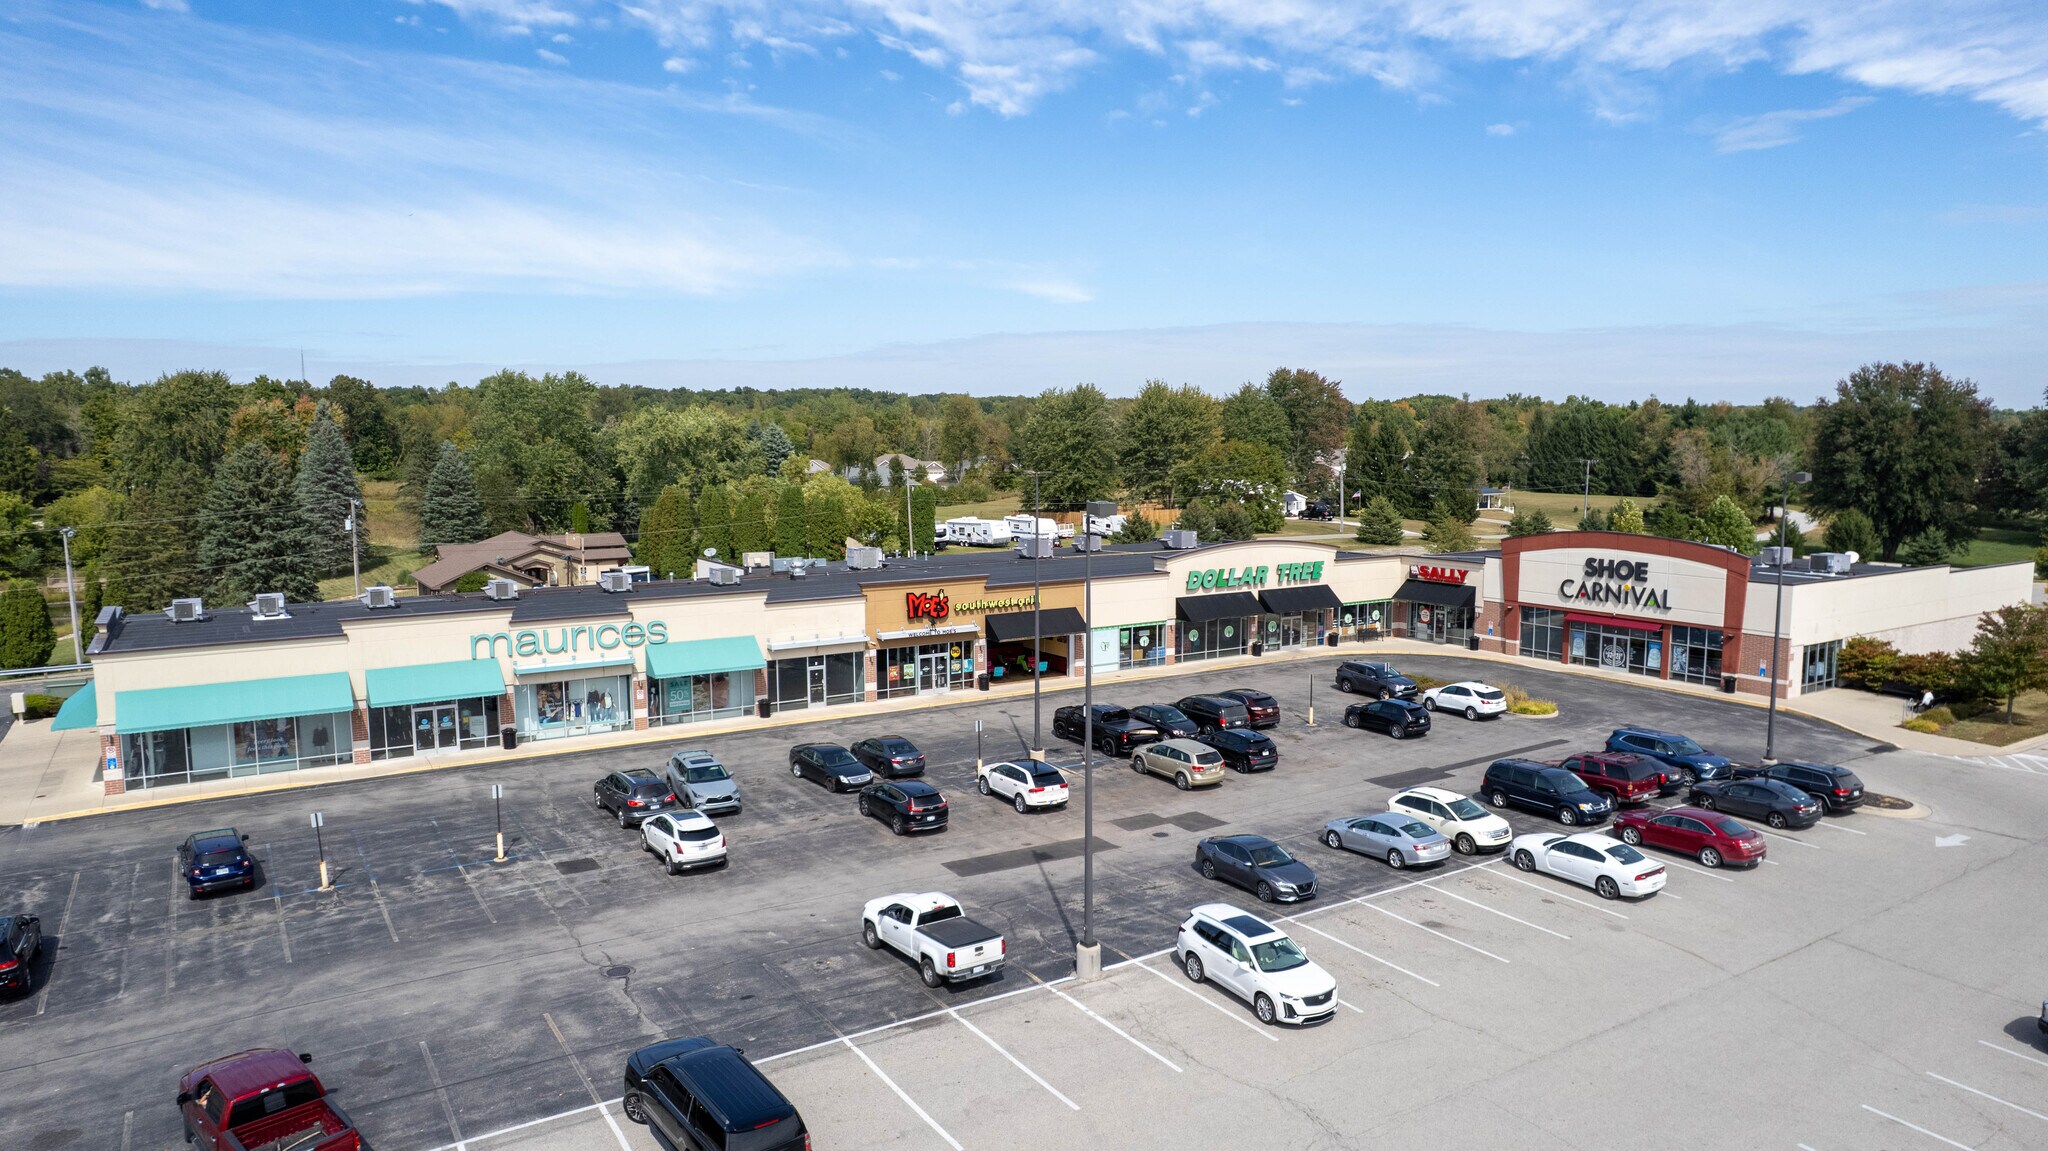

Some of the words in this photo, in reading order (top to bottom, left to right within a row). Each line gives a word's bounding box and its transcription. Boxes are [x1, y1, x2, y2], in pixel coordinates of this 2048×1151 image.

[1186, 565, 1269, 590] DOLLAR
[1277, 560, 1325, 582] TREE
[1419, 565, 1469, 584] SALLY
[1584, 557, 1649, 583] SHOE
[954, 597, 1015, 612] southwest
[1559, 578, 1672, 611] CARNIVAL
[470, 619, 669, 660] maurices
[670, 680, 688, 688] SALE
